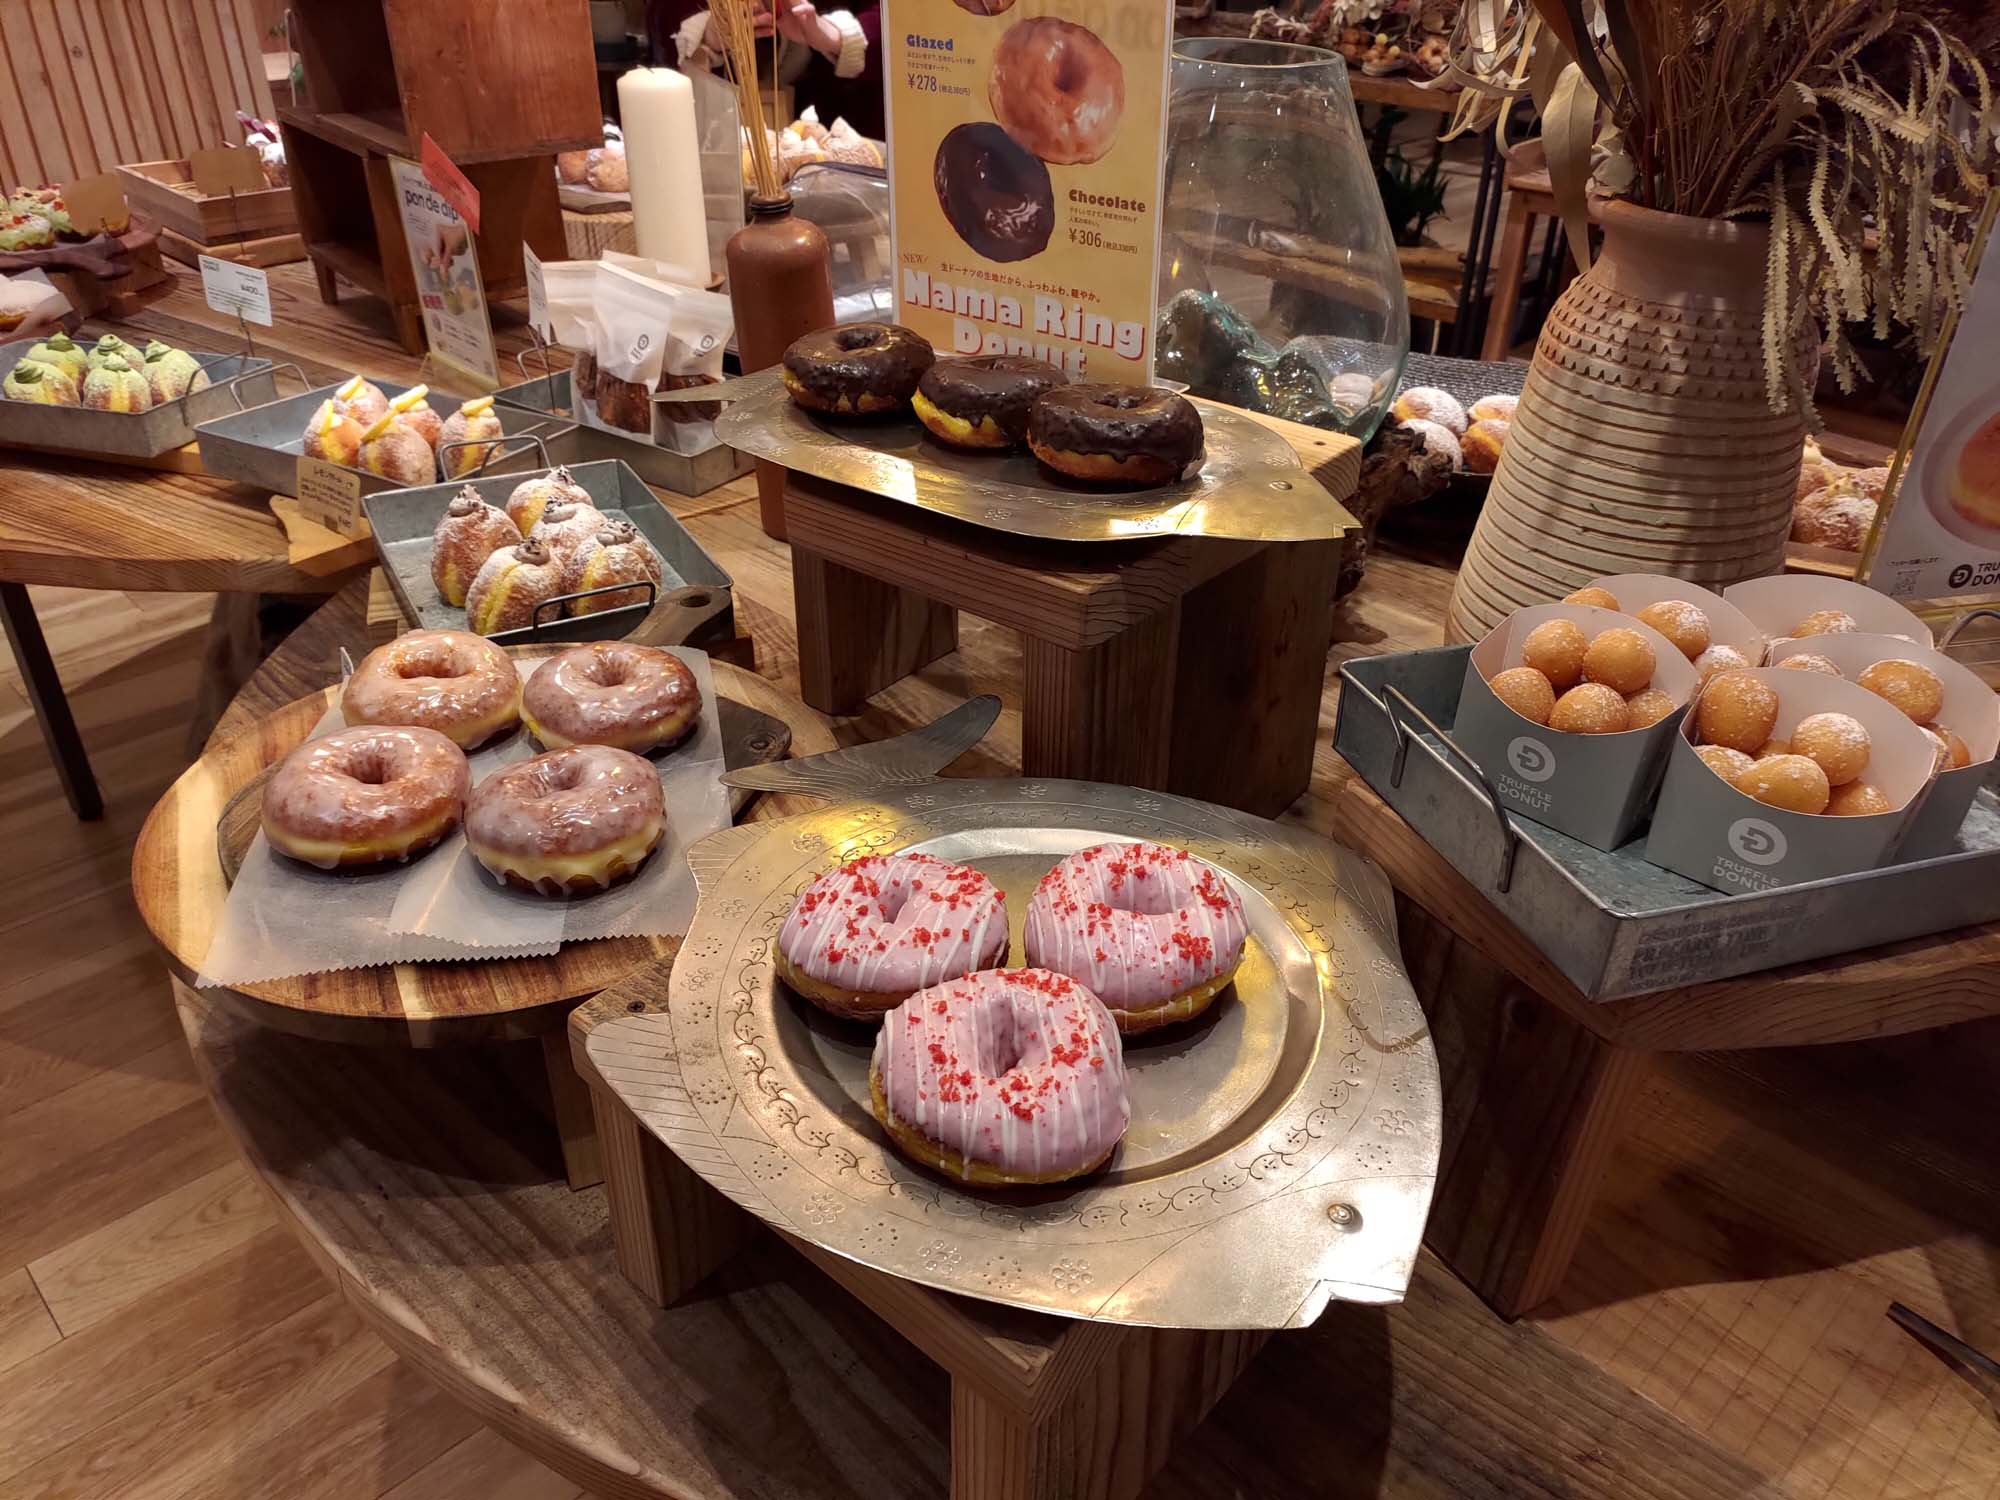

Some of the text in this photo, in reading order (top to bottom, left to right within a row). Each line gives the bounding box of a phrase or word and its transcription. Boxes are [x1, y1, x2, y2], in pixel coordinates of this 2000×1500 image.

[906, 33, 954, 51] Glazed
[907, 73, 937, 92] ¥278
[1069, 188, 1146, 213] Chocolate
[1069, 227, 1102, 248] ¥306
[903, 268, 1145, 361] Nama Ring
[1498, 782, 1553, 813] DONUT
[1500, 773, 1553, 803] TRUFFLE
[1716, 855, 1781, 887] TRUFFLE
